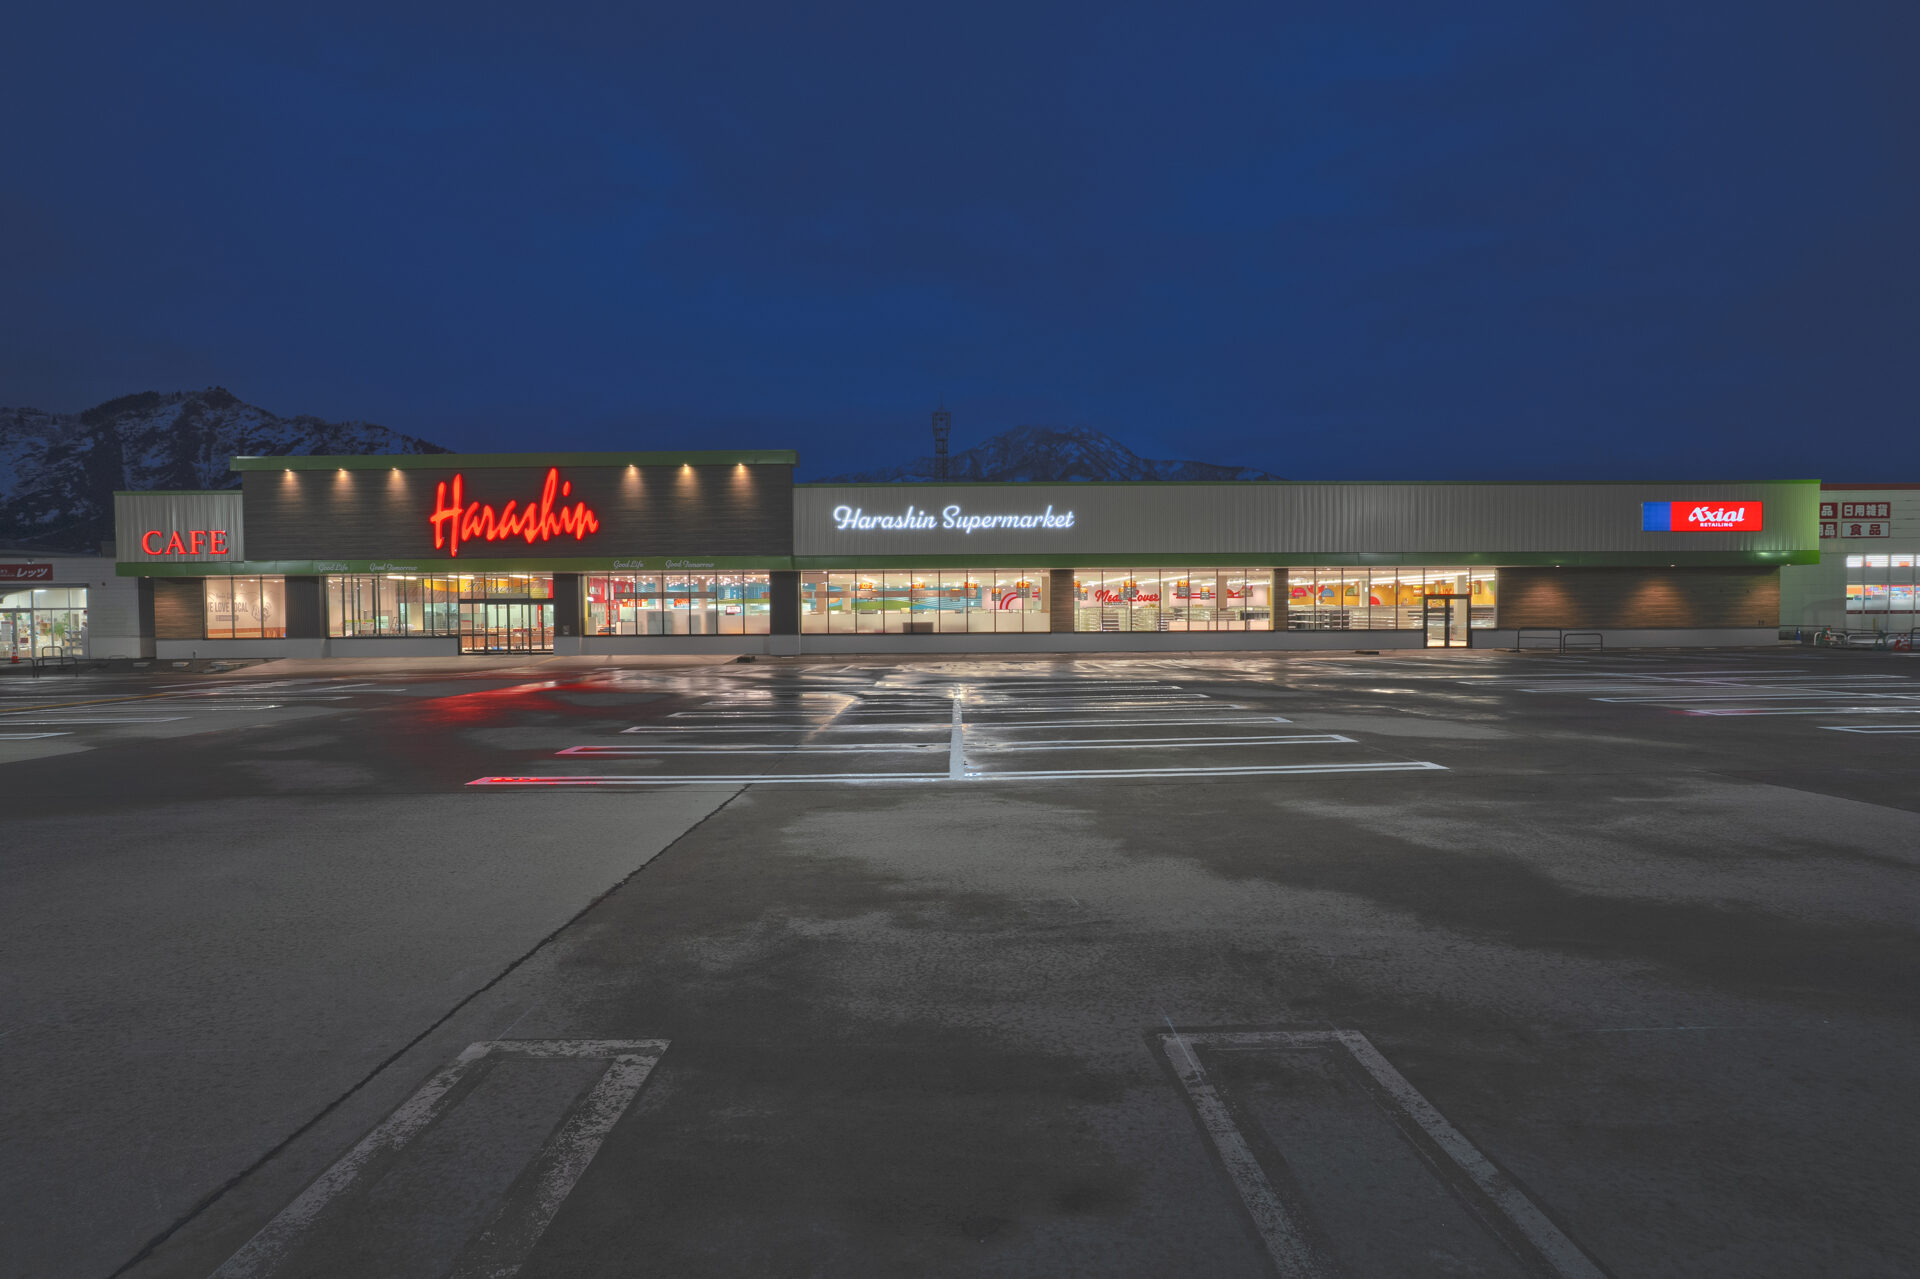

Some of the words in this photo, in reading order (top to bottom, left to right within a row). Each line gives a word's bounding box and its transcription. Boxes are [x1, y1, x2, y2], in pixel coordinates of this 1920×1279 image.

[430, 467, 599, 558] Harashin
[1688, 506, 1745, 522] Axial
[1844, 504, 1888, 517] 日用雑貨
[833, 504, 937, 530] Harashin
[942, 504, 1075, 535] Supermarket
[1850, 523, 1881, 536] 食品
[142, 530, 228, 555] CAFE
[318, 562, 334, 571] Good
[335, 563, 348, 571] Life
[369, 562, 386, 571] Good
[387, 563, 417, 571] Tomorrow
[613, 560, 630, 569] Good
[630, 560, 644, 569] Life
[665, 559, 682, 569] Good
[683, 560, 714, 568] Tomorrow
[16, 567, 48, 578] レッツ
[1094, 589, 1123, 602] Mea
[215, 602, 230, 613] LOVE
[231, 602, 249, 613] OCAL
